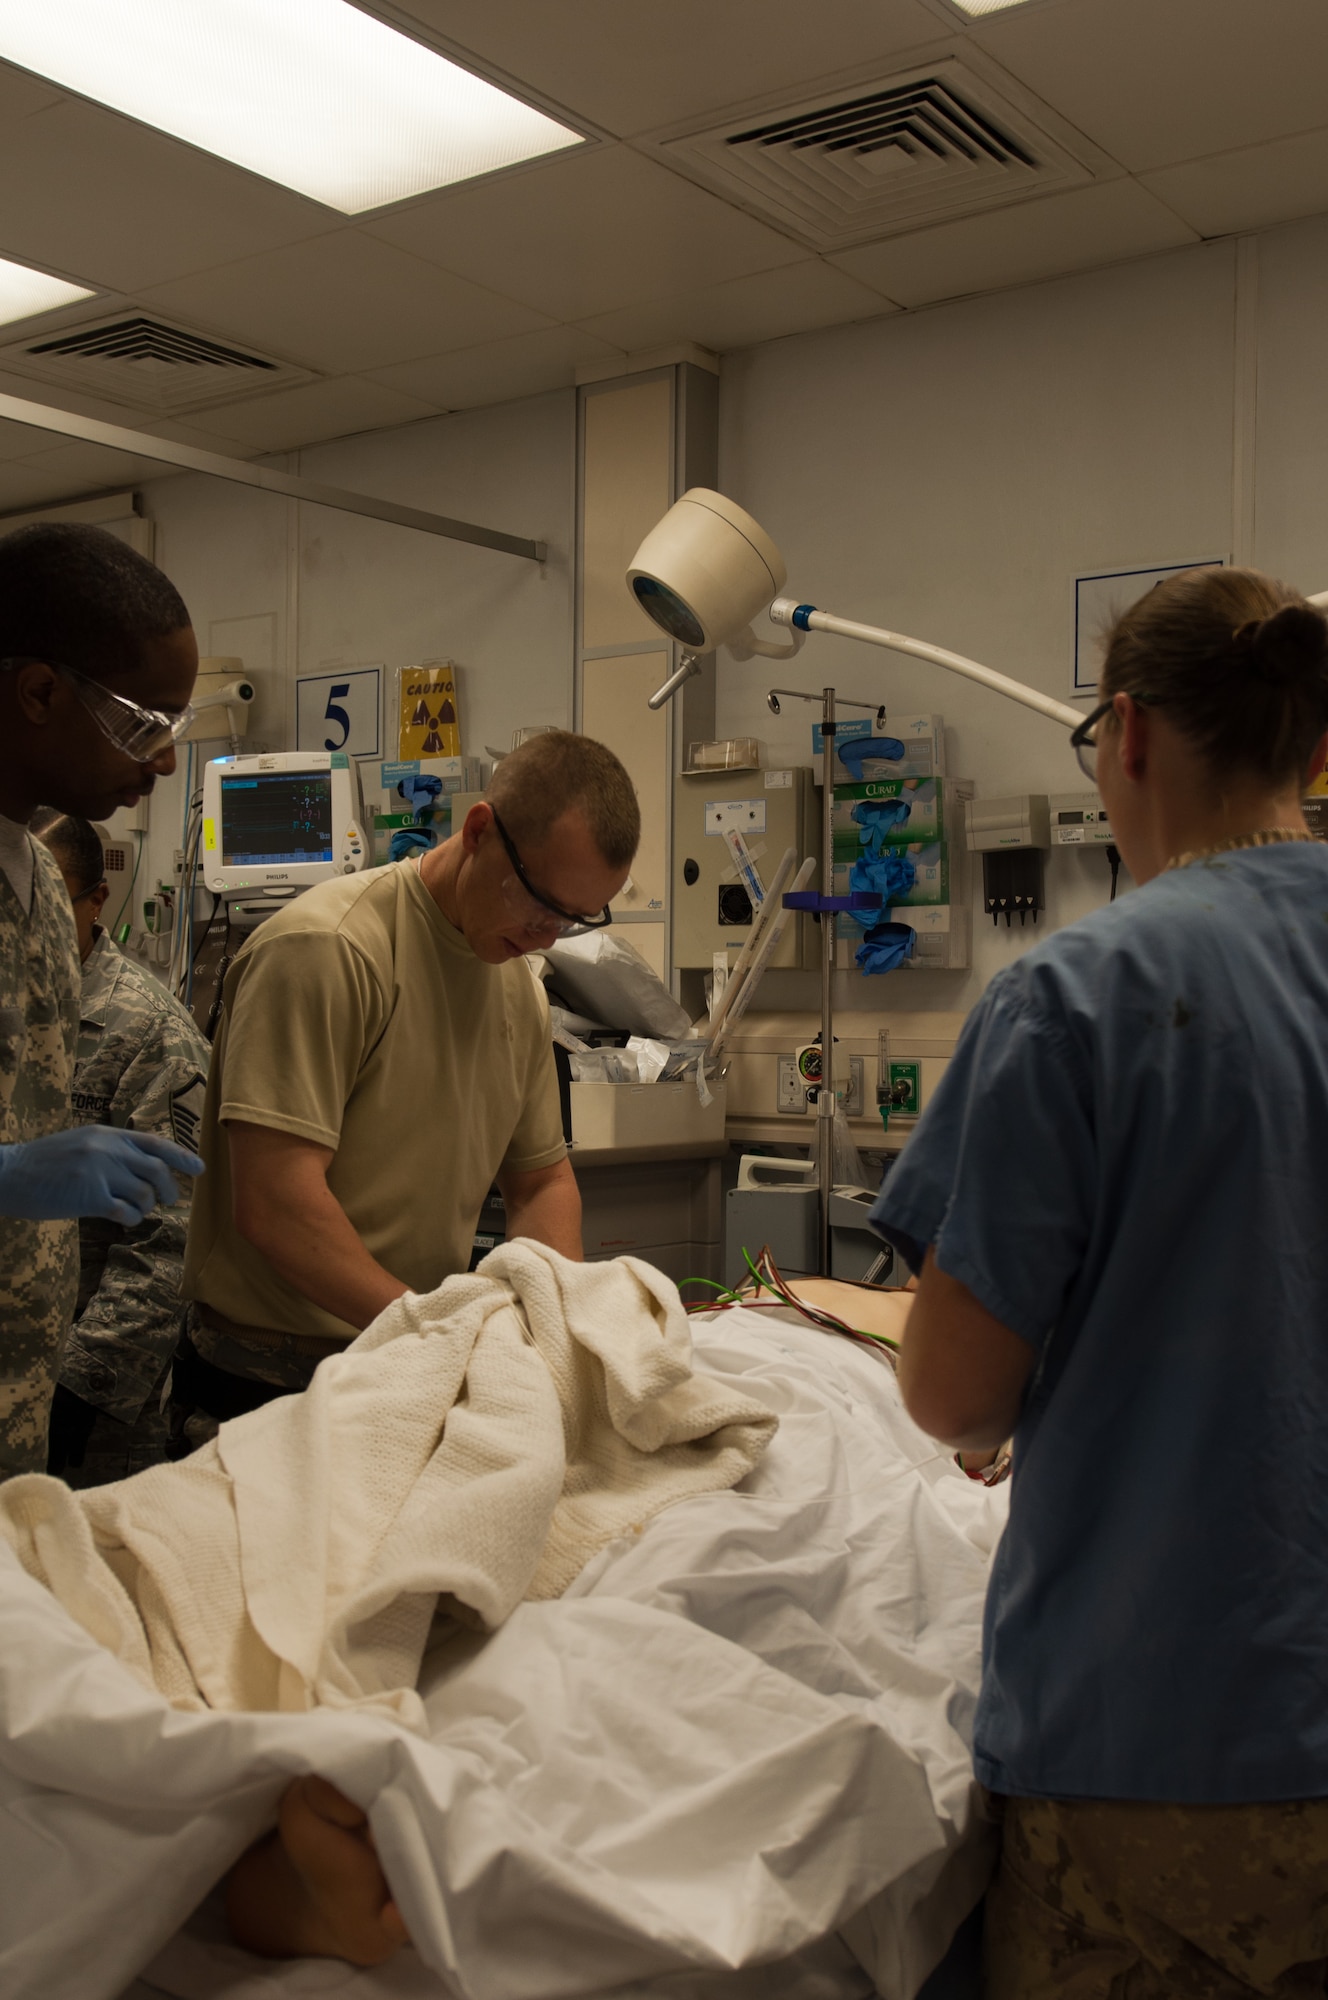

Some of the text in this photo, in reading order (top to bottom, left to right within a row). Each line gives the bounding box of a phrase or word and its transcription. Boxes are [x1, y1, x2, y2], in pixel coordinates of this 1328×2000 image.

[407, 681, 455, 696] CAUTIO
[324, 683, 350, 751] 5
[866, 783, 896, 797] CURAD
[72, 1093, 112, 1111] FORCE
